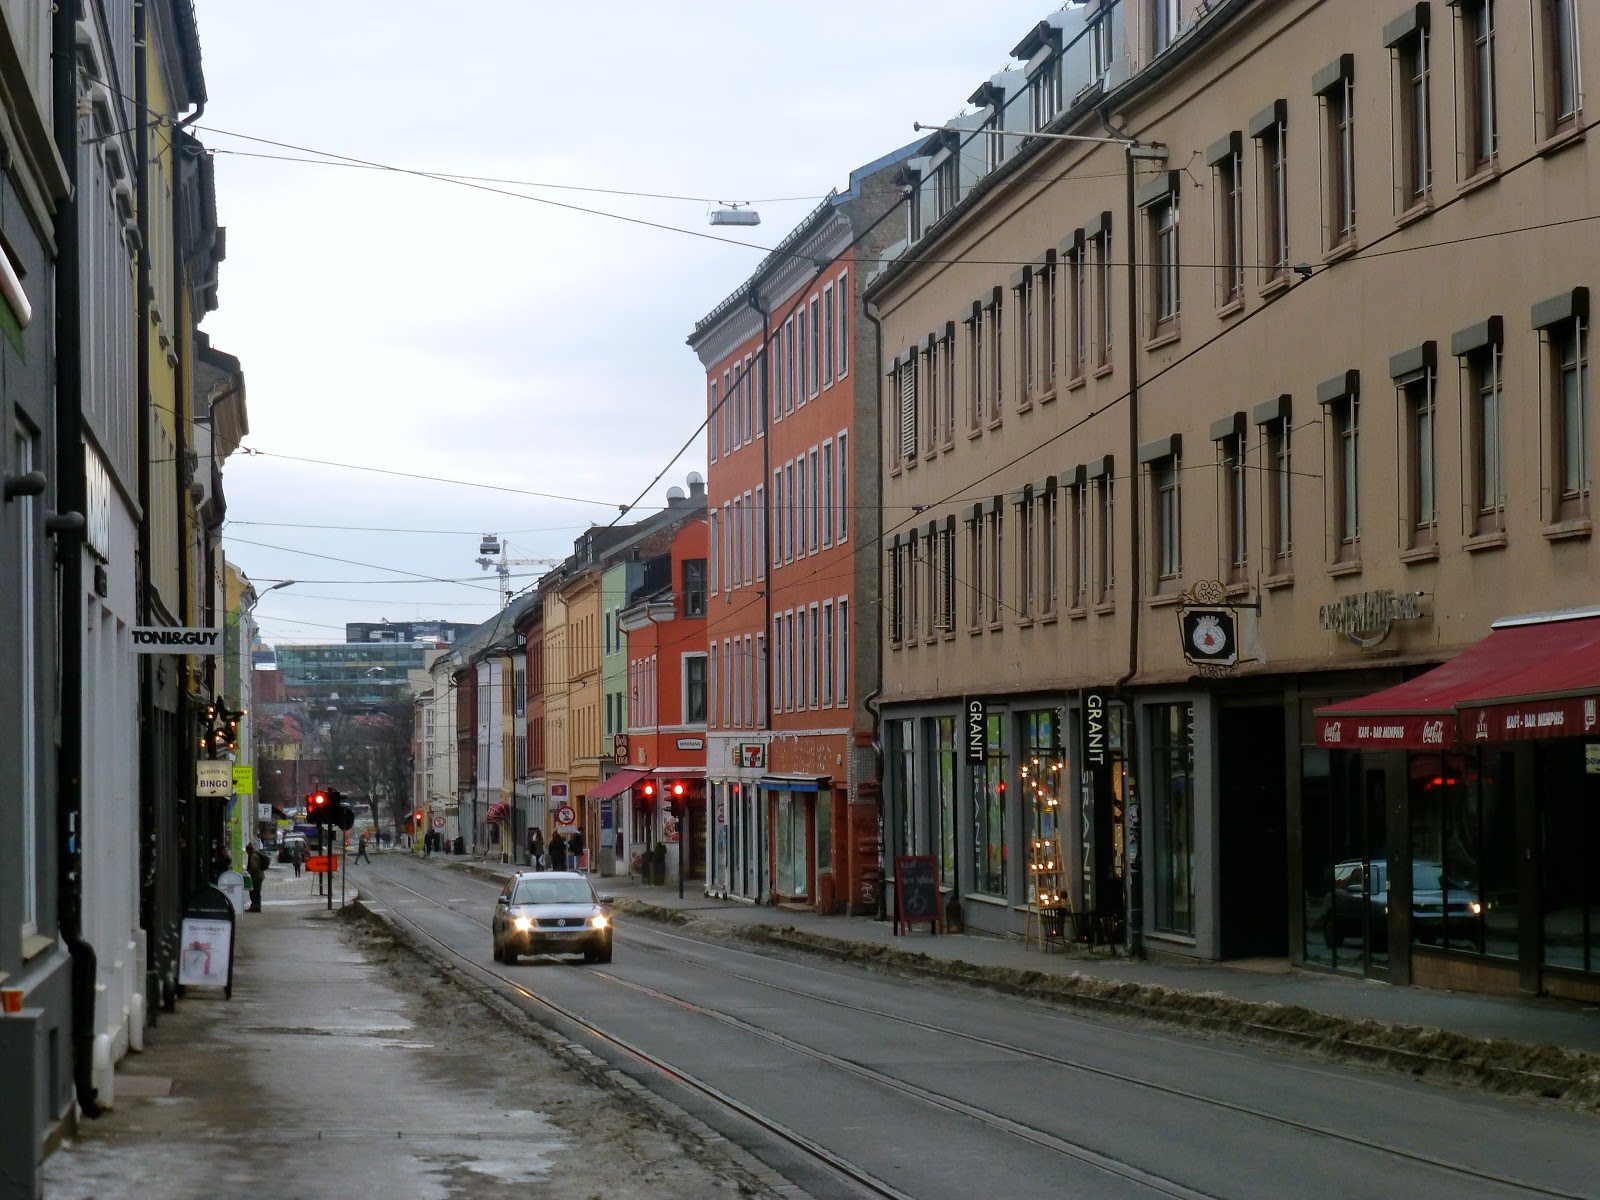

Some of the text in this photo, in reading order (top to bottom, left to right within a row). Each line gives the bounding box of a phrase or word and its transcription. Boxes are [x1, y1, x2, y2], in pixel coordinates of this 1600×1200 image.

[131, 630, 219, 646] TONI&GUY
[1524, 713, 1536, 728] BAR
[1537, 710, 1564, 727] MEMPHIS
[969, 700, 983, 761] GRANIT
[1087, 694, 1104, 765] GRANIT
[1373, 726, 1383, 738] BAR
[1382, 725, 1404, 738] MEMPHIS
[615, 753, 629, 765] Luca
[745, 746, 761, 767] 7
[200, 780, 228, 788] BINGO
